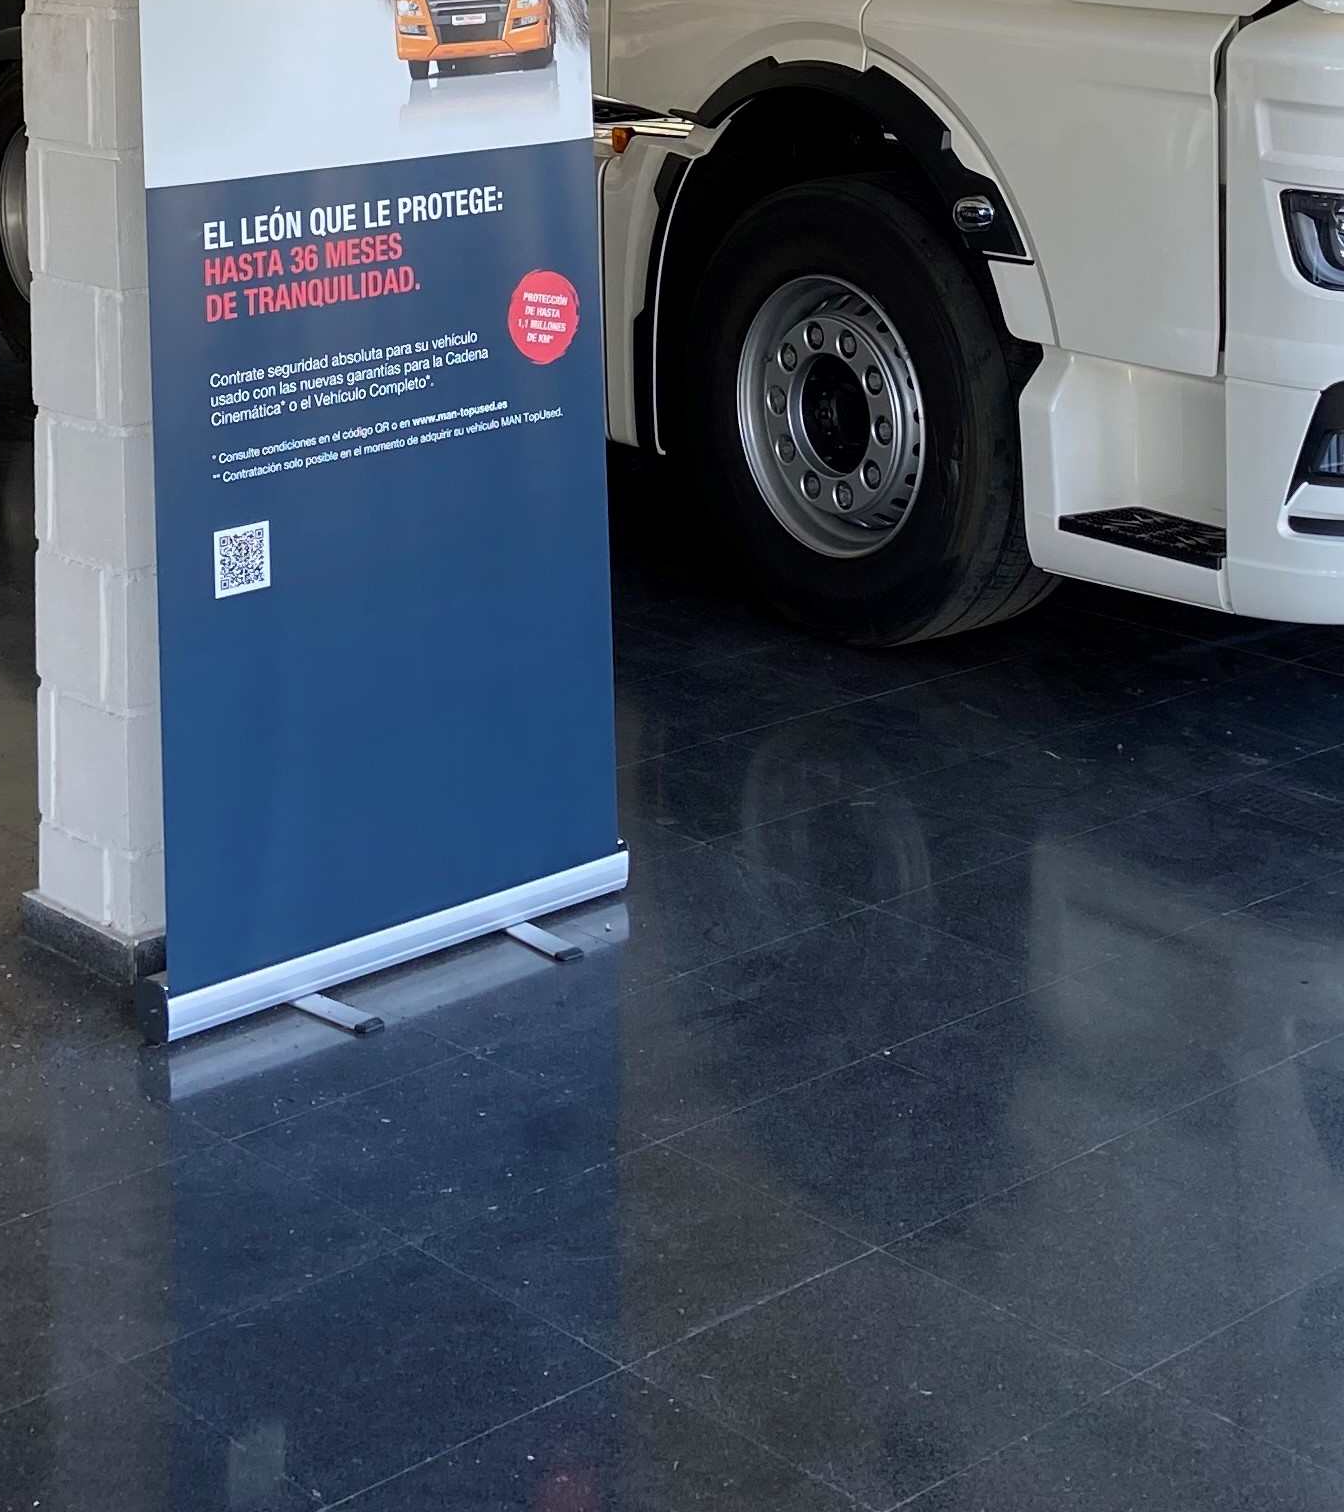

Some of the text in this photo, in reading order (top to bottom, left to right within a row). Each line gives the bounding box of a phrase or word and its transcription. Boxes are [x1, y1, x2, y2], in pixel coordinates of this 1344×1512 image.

[203, 185, 503, 250] EL LEÓN QUE LE PROTEGE:
[204, 232, 403, 287] HASTA 36 MESES
[206, 265, 421, 323] DE TRANQUILIDAD.
[522, 291, 569, 307] PROTECCIÓN
[525, 305, 561, 319] DE HASTA
[526, 332, 537, 343] DE
[530, 319, 567, 333] MILLONES
[210, 330, 478, 388] Contrate seguridad absoluta para su vehículo
[210, 348, 489, 408] usado con las nuevas garantías para la Cadena
[288, 401, 298, 413] o
[300, 395, 312, 410] el
[314, 387, 367, 408] Vehículo
[218, 447, 260, 464] Consulte
[261, 436, 317, 456] condiciones
[318, 433, 330, 445] en
[331, 430, 341, 442] el
[342, 424, 373, 441] código
[374, 421, 390, 434] QR
[391, 422, 398, 431] o
[399, 418, 411, 430] en
[412, 400, 508, 427] www.man-topused.es
[222, 462, 282, 483] Contratación
[283, 457, 303, 471] solo
[305, 450, 339, 468] posible
[340, 448, 352, 460] en
[353, 445, 362, 457] el
[363, 437, 405, 456] momento
[406, 435, 419, 446] de
[420, 428, 452, 444] adquirir
[453, 427, 464, 437] su
[501, 414, 522, 427] MAN
[523, 406, 564, 423] TopUsed.
